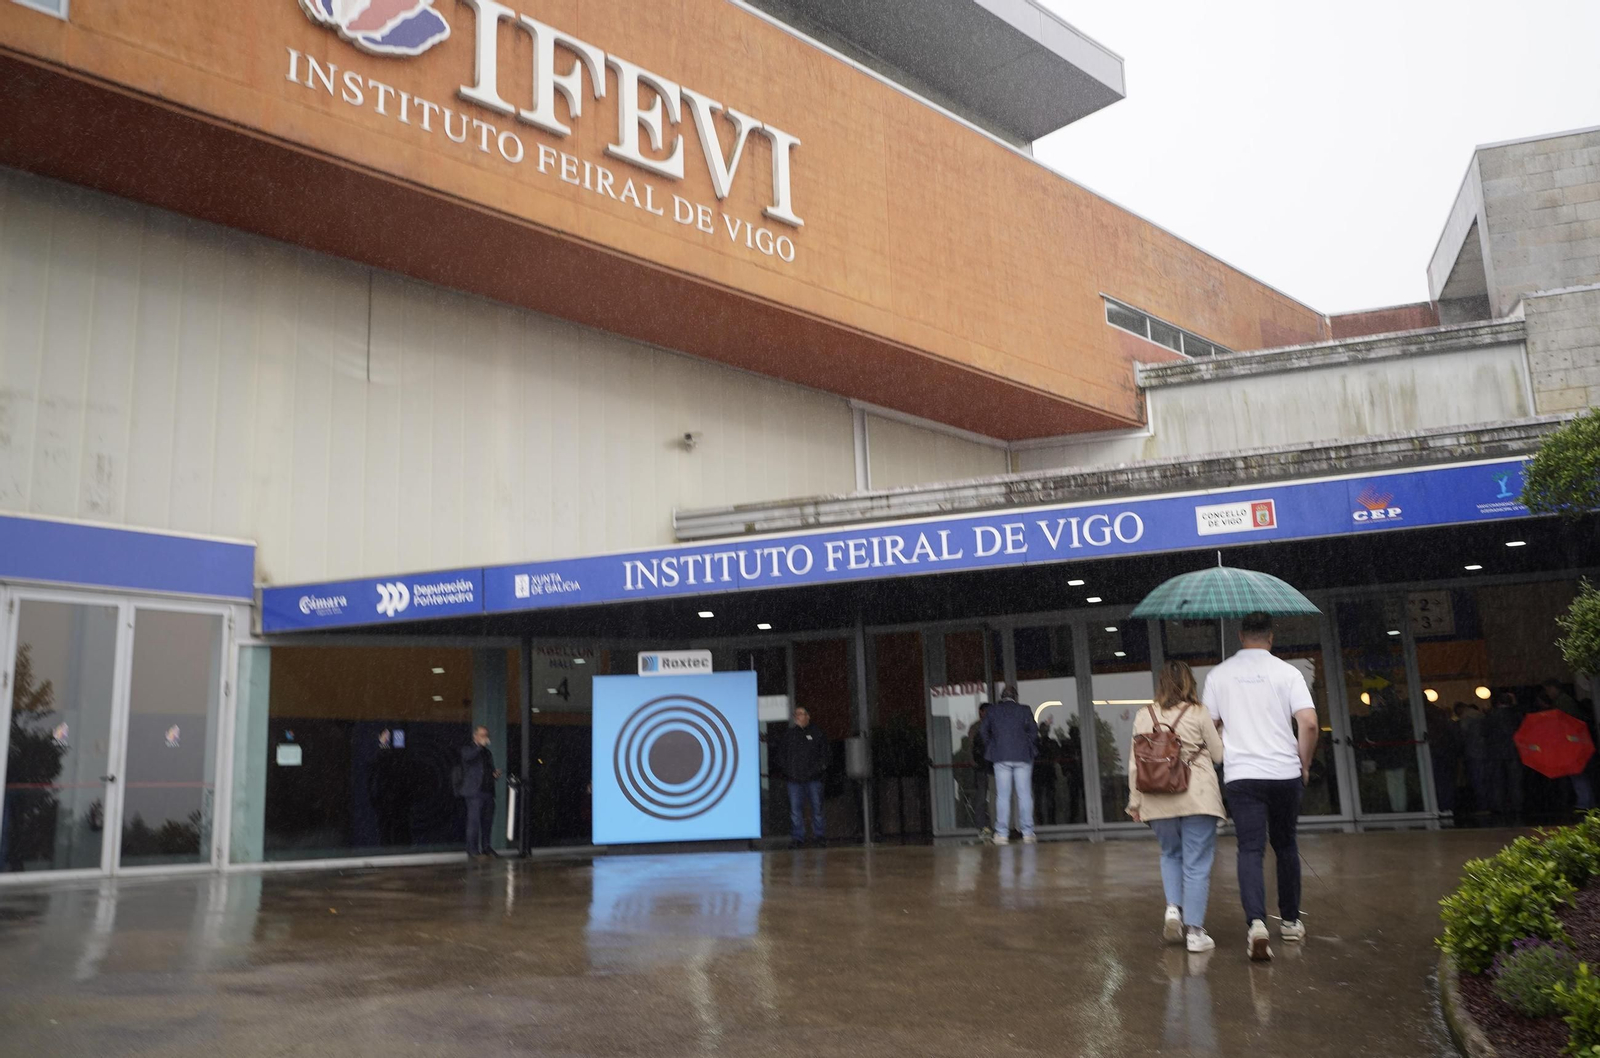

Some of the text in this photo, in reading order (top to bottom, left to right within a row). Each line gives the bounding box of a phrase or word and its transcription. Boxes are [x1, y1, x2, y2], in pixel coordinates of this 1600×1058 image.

[458, 0, 804, 227] IFEVI
[285, 46, 796, 263] INSTITUTO FEIRAL DE VIGO
[1201, 508, 1247, 520] CONCELLO
[1353, 507, 1402, 521] CEP
[1208, 517, 1243, 528] DE VIGO
[622, 511, 1145, 591] INSTITUTO FEIRAL DE VIGO
[531, 573, 561, 585] XUNTA
[531, 579, 581, 594] DE GALICIA
[413, 591, 474, 607] Pontevedra
[661, 657, 710, 669] Roxtec
[556, 676, 571, 701] 4
[931, 682, 986, 698] SALIDA
